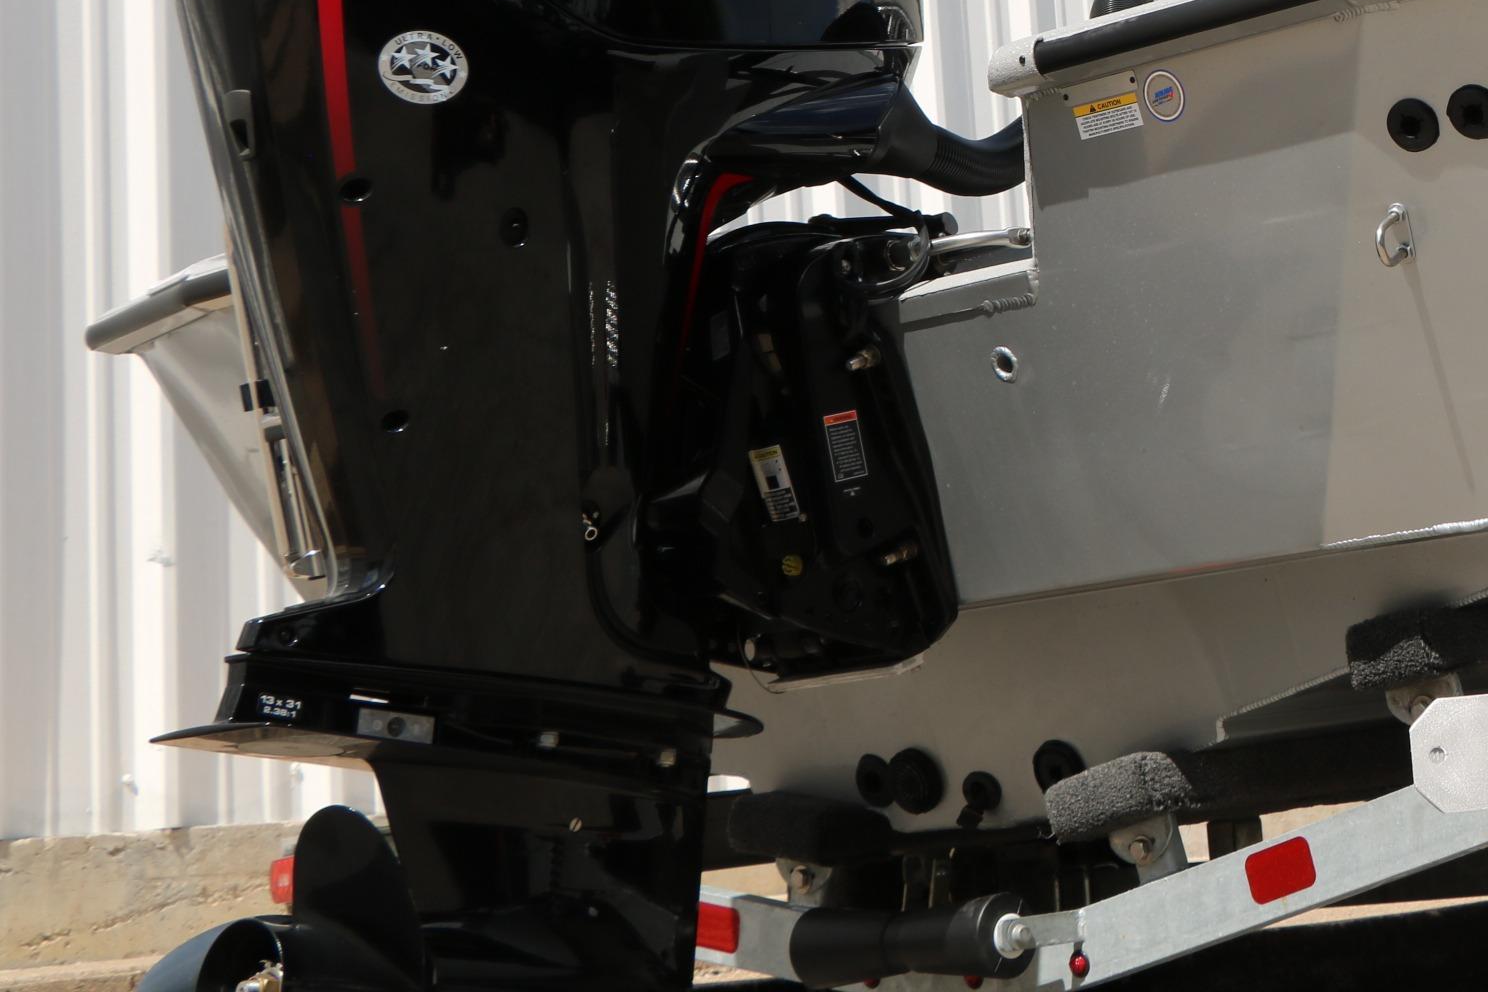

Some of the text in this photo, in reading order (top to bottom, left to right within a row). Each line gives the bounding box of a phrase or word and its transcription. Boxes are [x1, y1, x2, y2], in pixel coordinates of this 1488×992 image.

[441, 38, 463, 60] LOW
[1097, 98, 1122, 110] CAUTION
[259, 694, 276, 705] 13
[285, 698, 303, 710] 31
